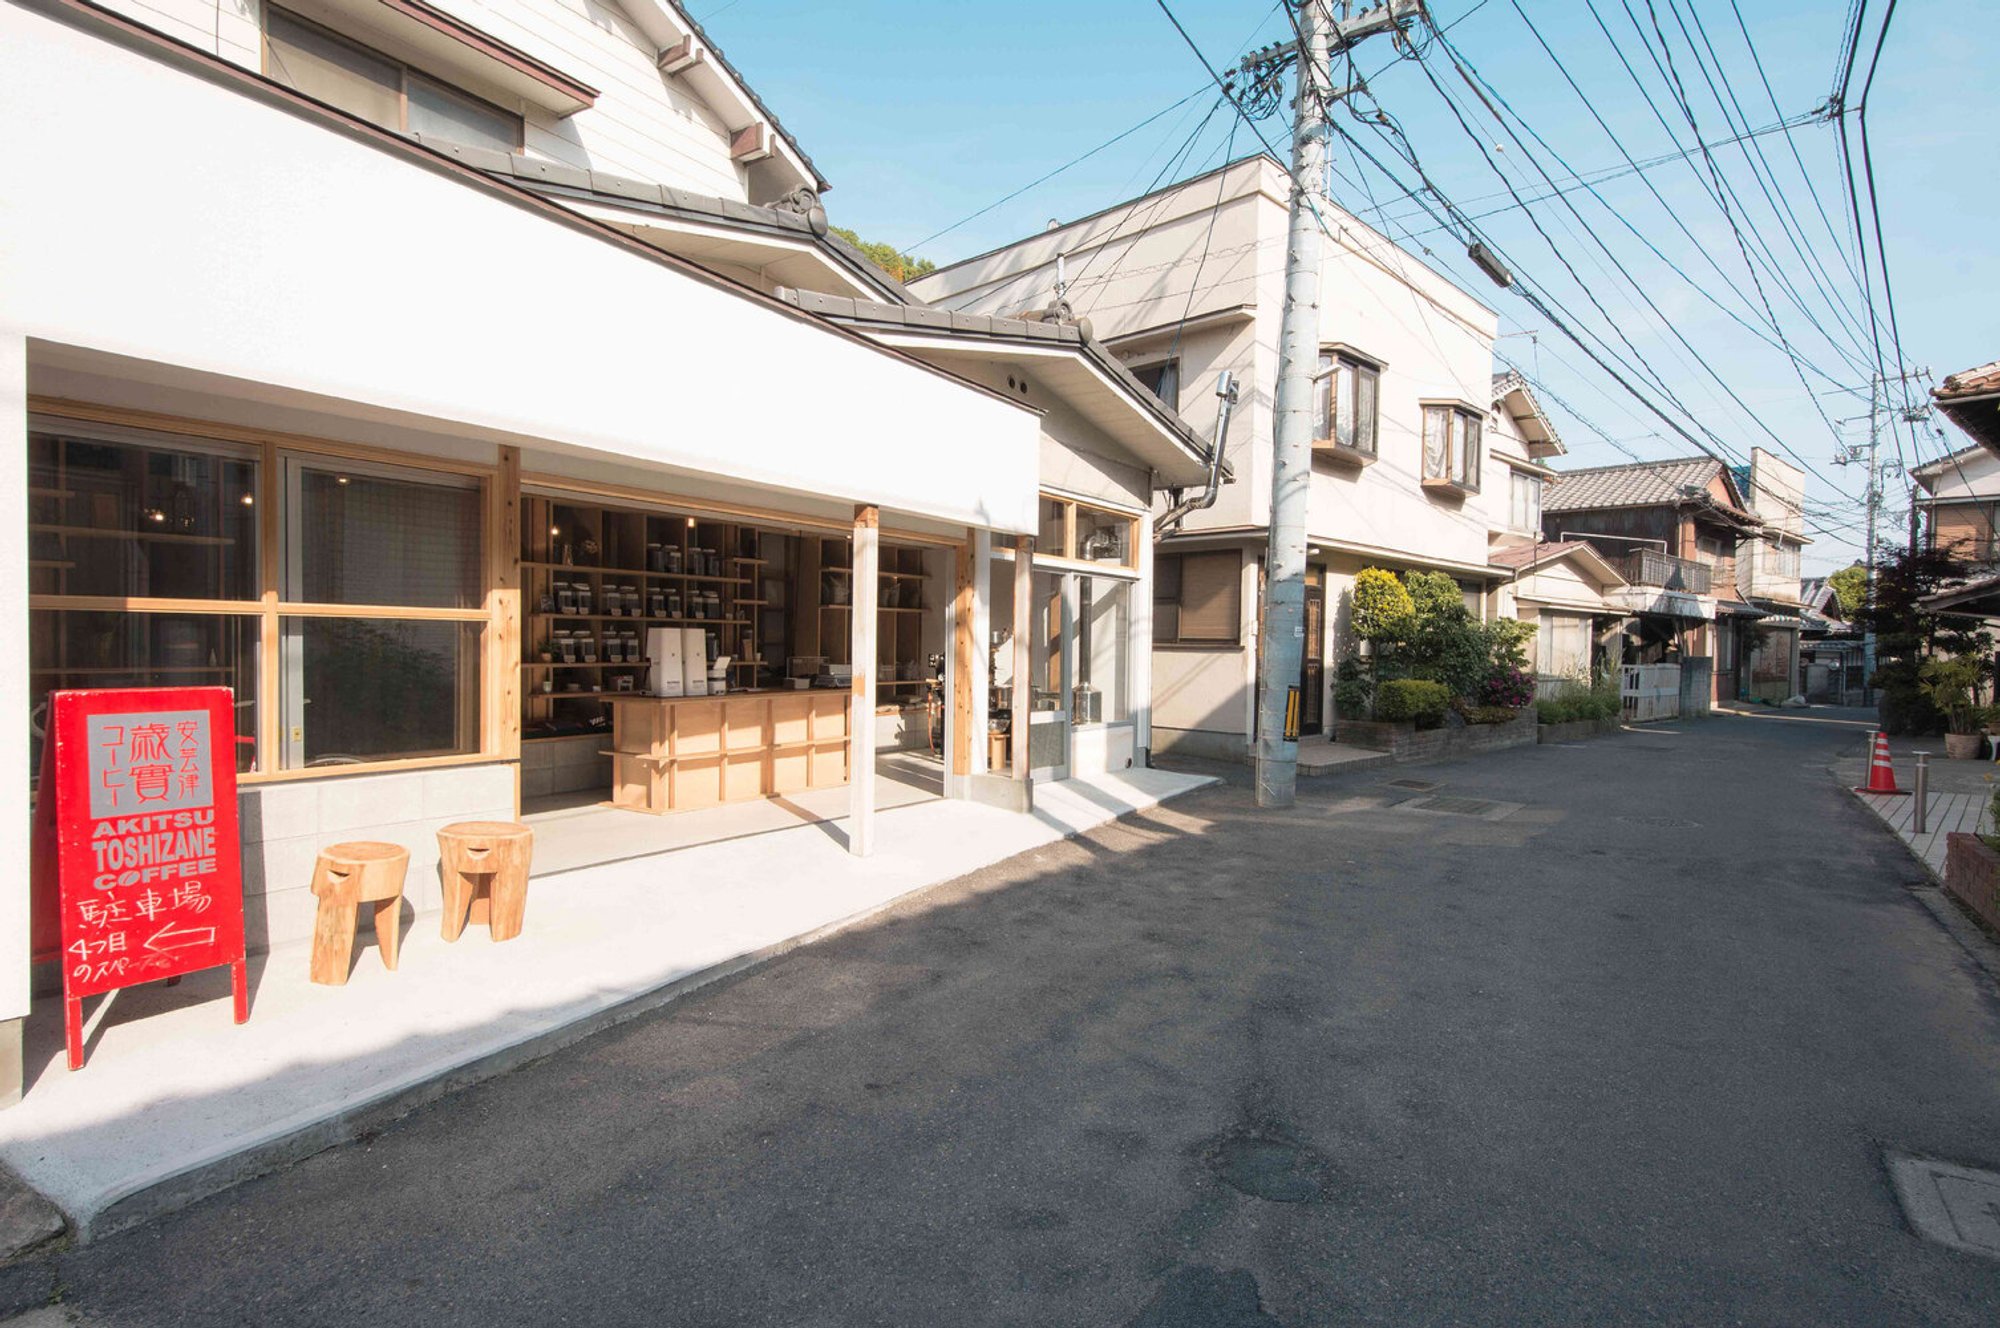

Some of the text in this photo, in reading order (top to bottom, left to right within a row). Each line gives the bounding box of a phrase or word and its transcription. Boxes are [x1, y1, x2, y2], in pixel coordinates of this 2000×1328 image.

[101, 725, 126, 807] コーヒー
[92, 811, 215, 838] AKITSU
[92, 827, 217, 873] TOSHIZANE
[93, 858, 217, 890] COFFEE
[77, 880, 213, 929] 駐車場
